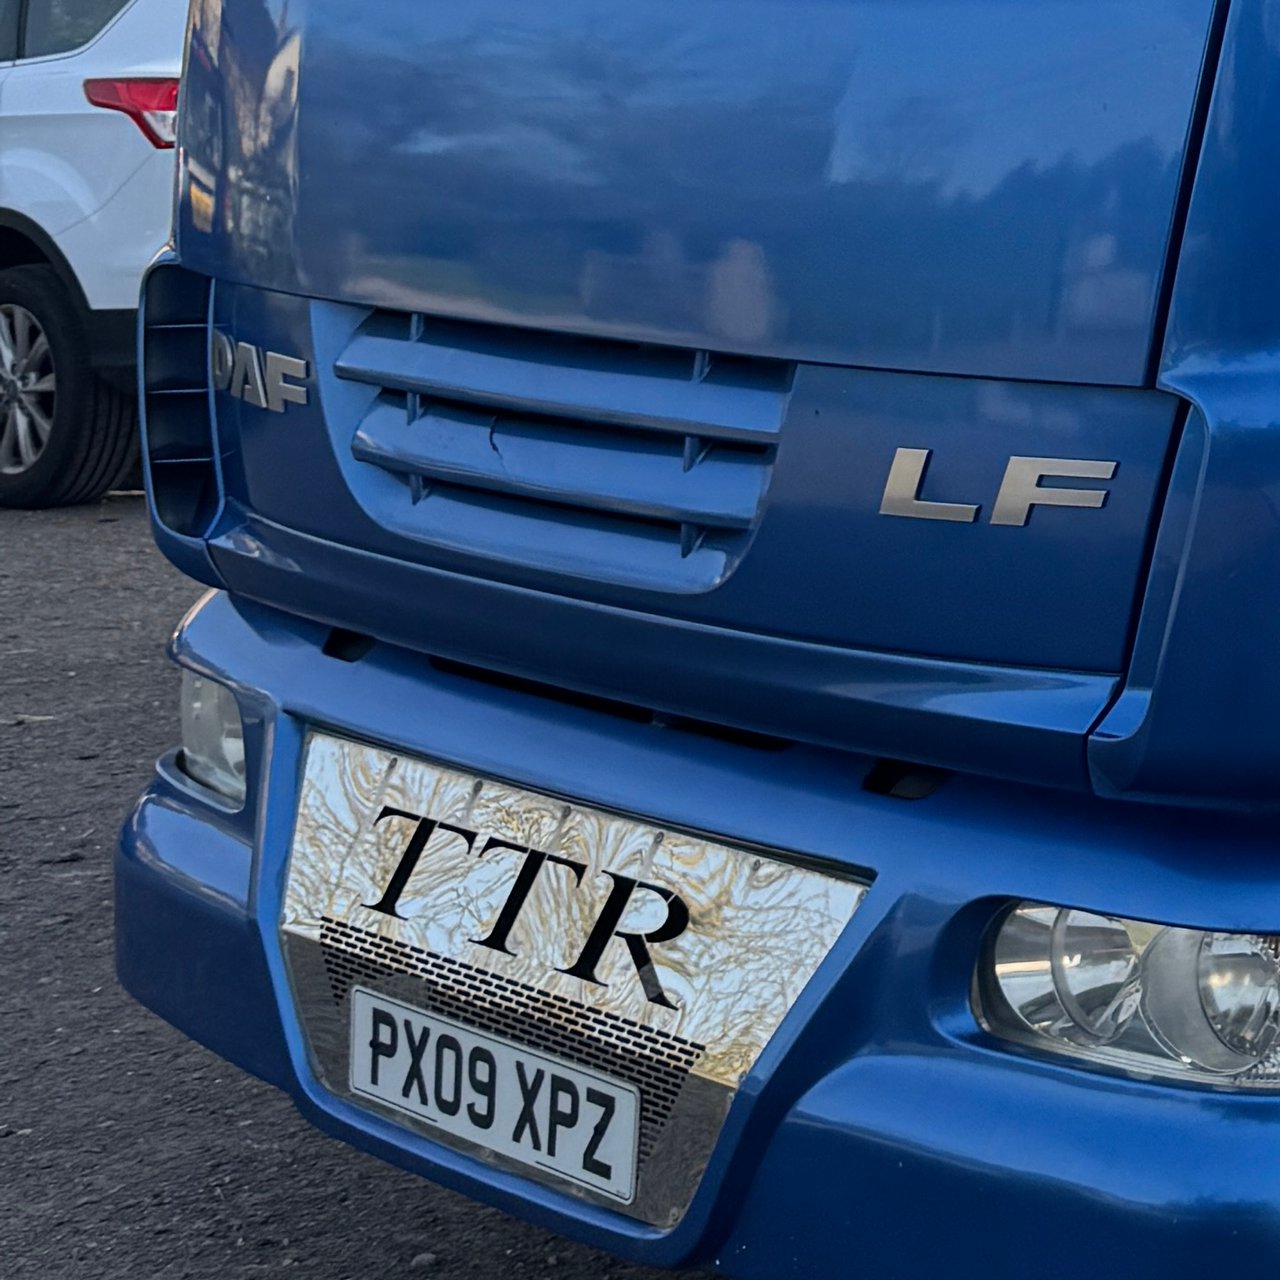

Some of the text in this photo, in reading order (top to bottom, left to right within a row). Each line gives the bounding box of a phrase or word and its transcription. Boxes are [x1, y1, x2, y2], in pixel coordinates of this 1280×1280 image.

[212, 329, 308, 412] DAF
[879, 447, 1119, 527] LF
[360, 805, 692, 1011] TTR
[369, 1009, 615, 1180] PX09 XPZ
